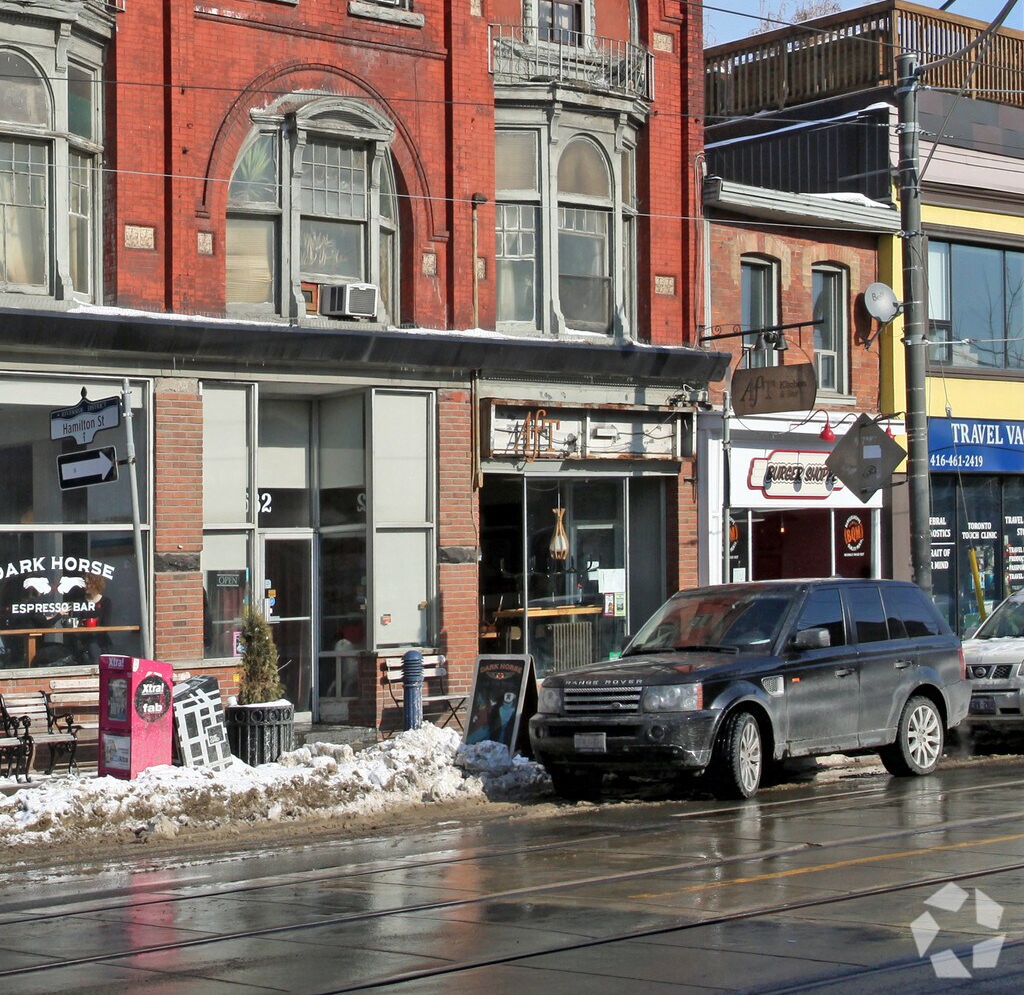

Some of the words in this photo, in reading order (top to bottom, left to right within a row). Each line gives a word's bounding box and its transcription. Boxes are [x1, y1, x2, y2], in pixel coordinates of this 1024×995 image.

[63, 419, 95, 434] Hamilton
[97, 415, 104, 426] St
[951, 423, 1003, 444] TRAVEL
[1006, 425, 1024, 445] VA
[930, 454, 983, 467] 416-461-2419
[766, 465, 804, 482] BURGER
[968, 522, 992, 530] TORONTO
[981, 531, 997, 539] CLINIC
[943, 549, 951, 557] OF
[51, 556, 116, 580] HORSE
[218, 576, 238, 585] OPEN
[12, 603, 69, 614] ESPRESSO
[73, 602, 96, 612] BAR
[108, 657, 124, 667] Xtra!
[480, 664, 498, 673] DARK
[500, 663, 522, 674] HORSE
[142, 683, 164, 694] Xtra!
[143, 703, 162, 713] fab
